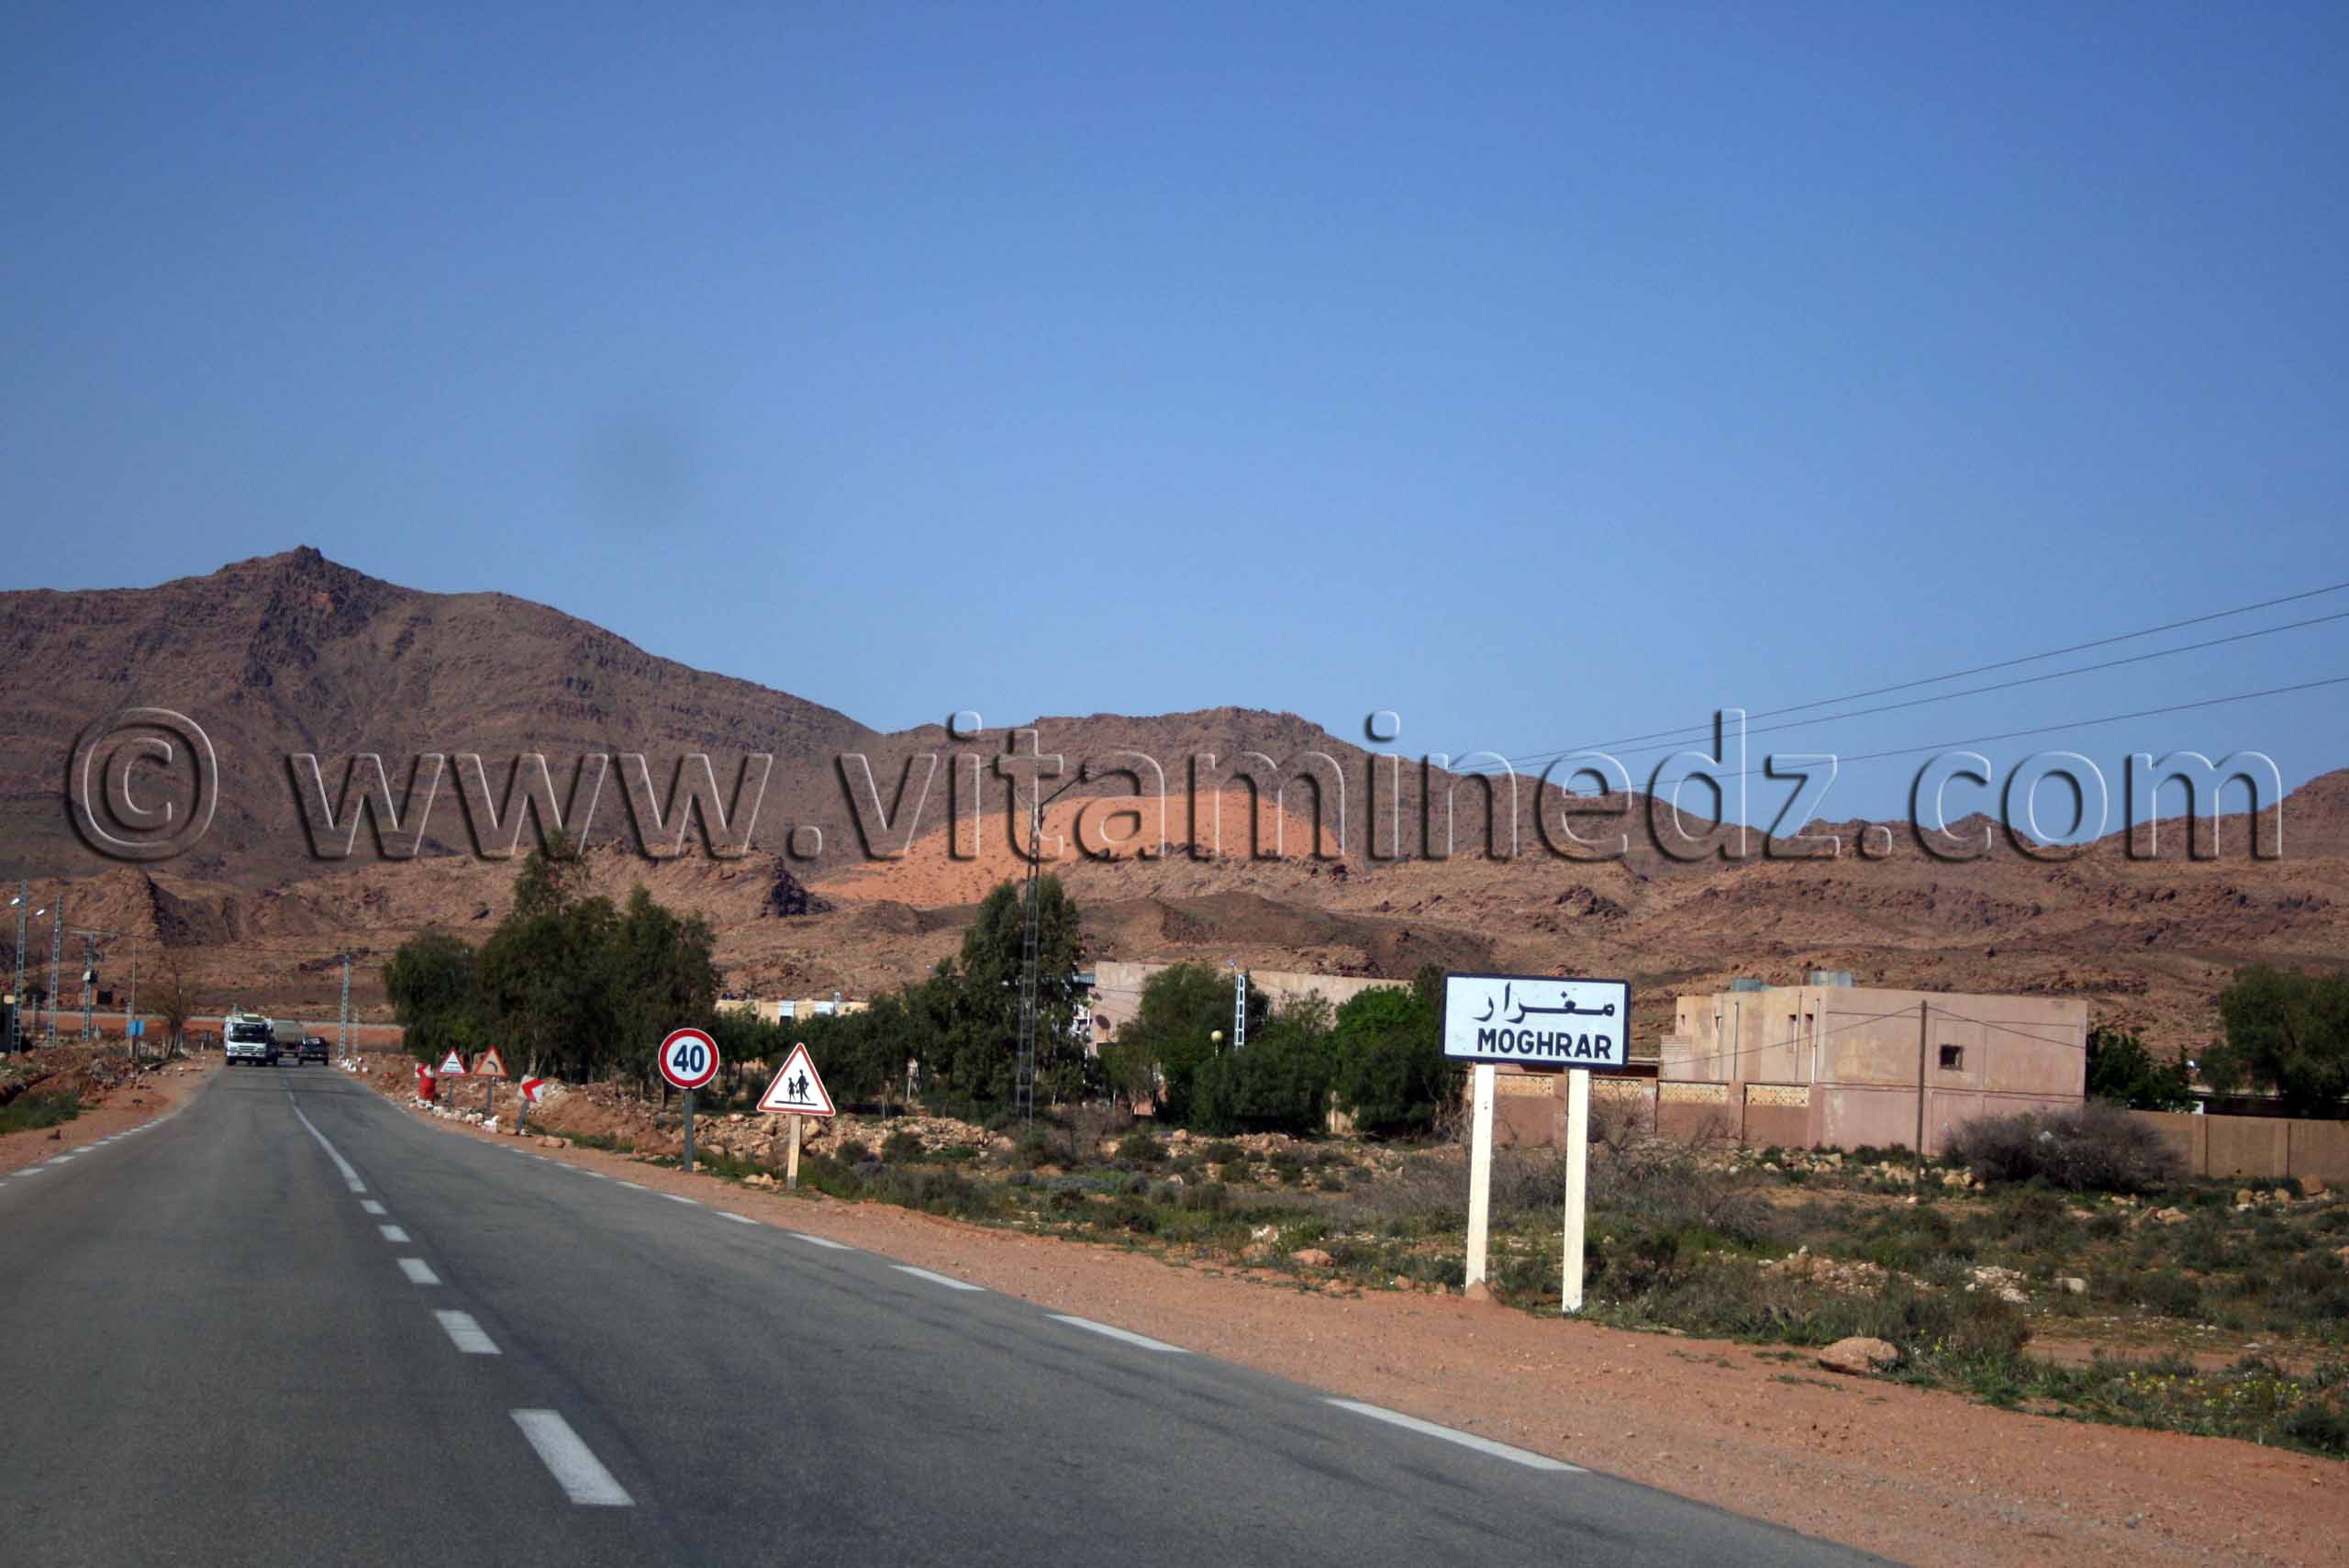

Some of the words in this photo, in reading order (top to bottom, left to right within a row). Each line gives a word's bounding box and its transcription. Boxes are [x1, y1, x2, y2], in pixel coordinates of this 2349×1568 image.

[1473, 982, 1615, 1024] مغرار
[673, 1044, 705, 1073] 40
[1477, 1028, 1612, 1059] MOGHRAR
